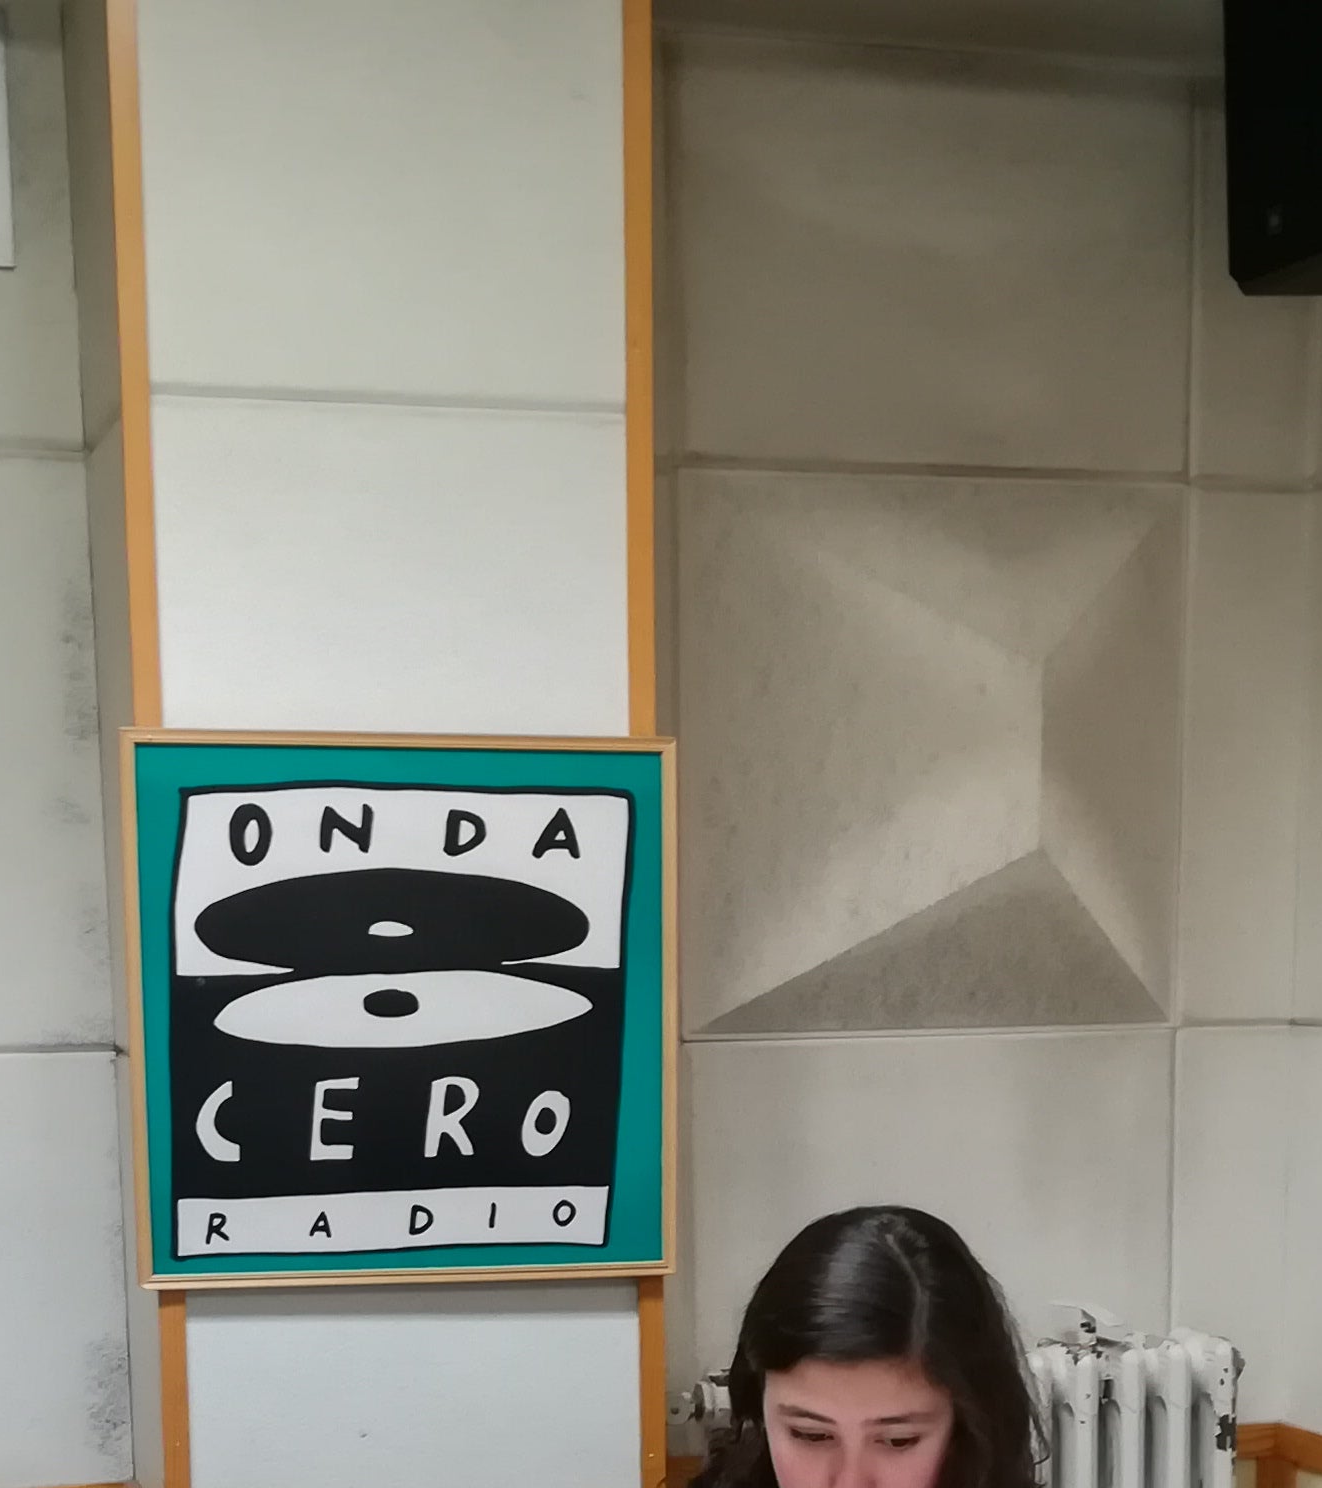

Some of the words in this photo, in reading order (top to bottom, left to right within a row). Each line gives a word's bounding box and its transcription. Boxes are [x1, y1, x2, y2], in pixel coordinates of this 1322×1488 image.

[228, 802, 581, 867] ONDA
[195, 1075, 572, 1163] CERO
[205, 1199, 578, 1246] RADIO
